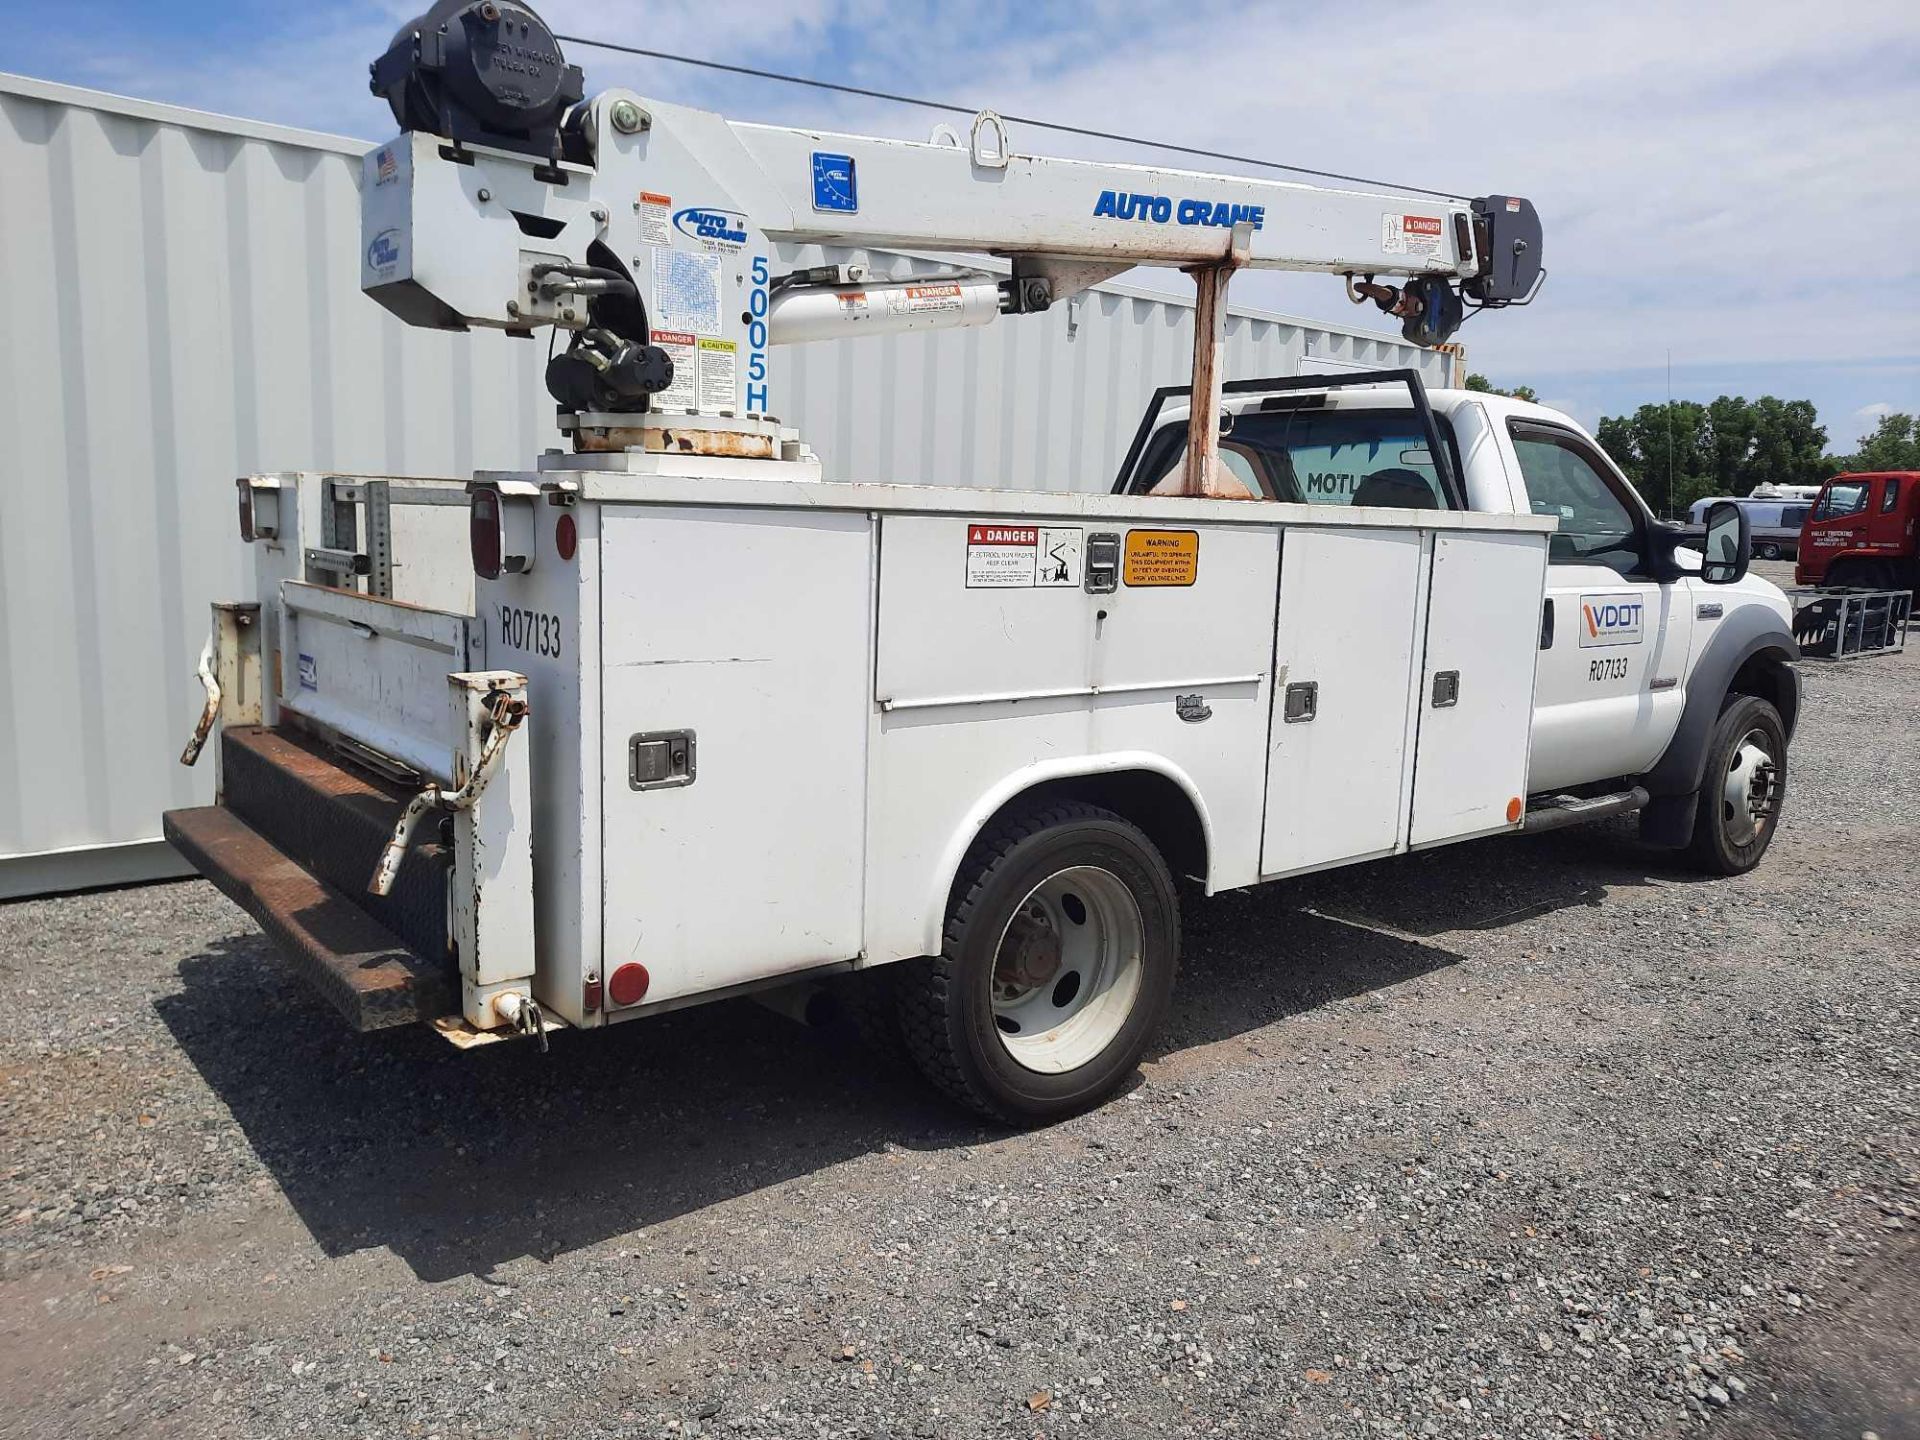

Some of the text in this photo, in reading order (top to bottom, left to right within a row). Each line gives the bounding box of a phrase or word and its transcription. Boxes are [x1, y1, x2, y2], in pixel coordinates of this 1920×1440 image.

[685, 210, 727, 229] AUTO
[1093, 190, 1265, 231] AUTO CRANE
[696, 224, 747, 243] CRANE
[1413, 220, 1440, 231] DANGER
[661, 333, 693, 345] DANGER
[746, 255, 769, 413] 5005H
[706, 342, 734, 351] CAUTION
[986, 530, 1036, 542] DANGER
[1145, 538, 1180, 548] WARNING
[1592, 604, 1642, 628] VDOT
[501, 605, 561, 658] R07133
[1588, 657, 1628, 682] R07133
